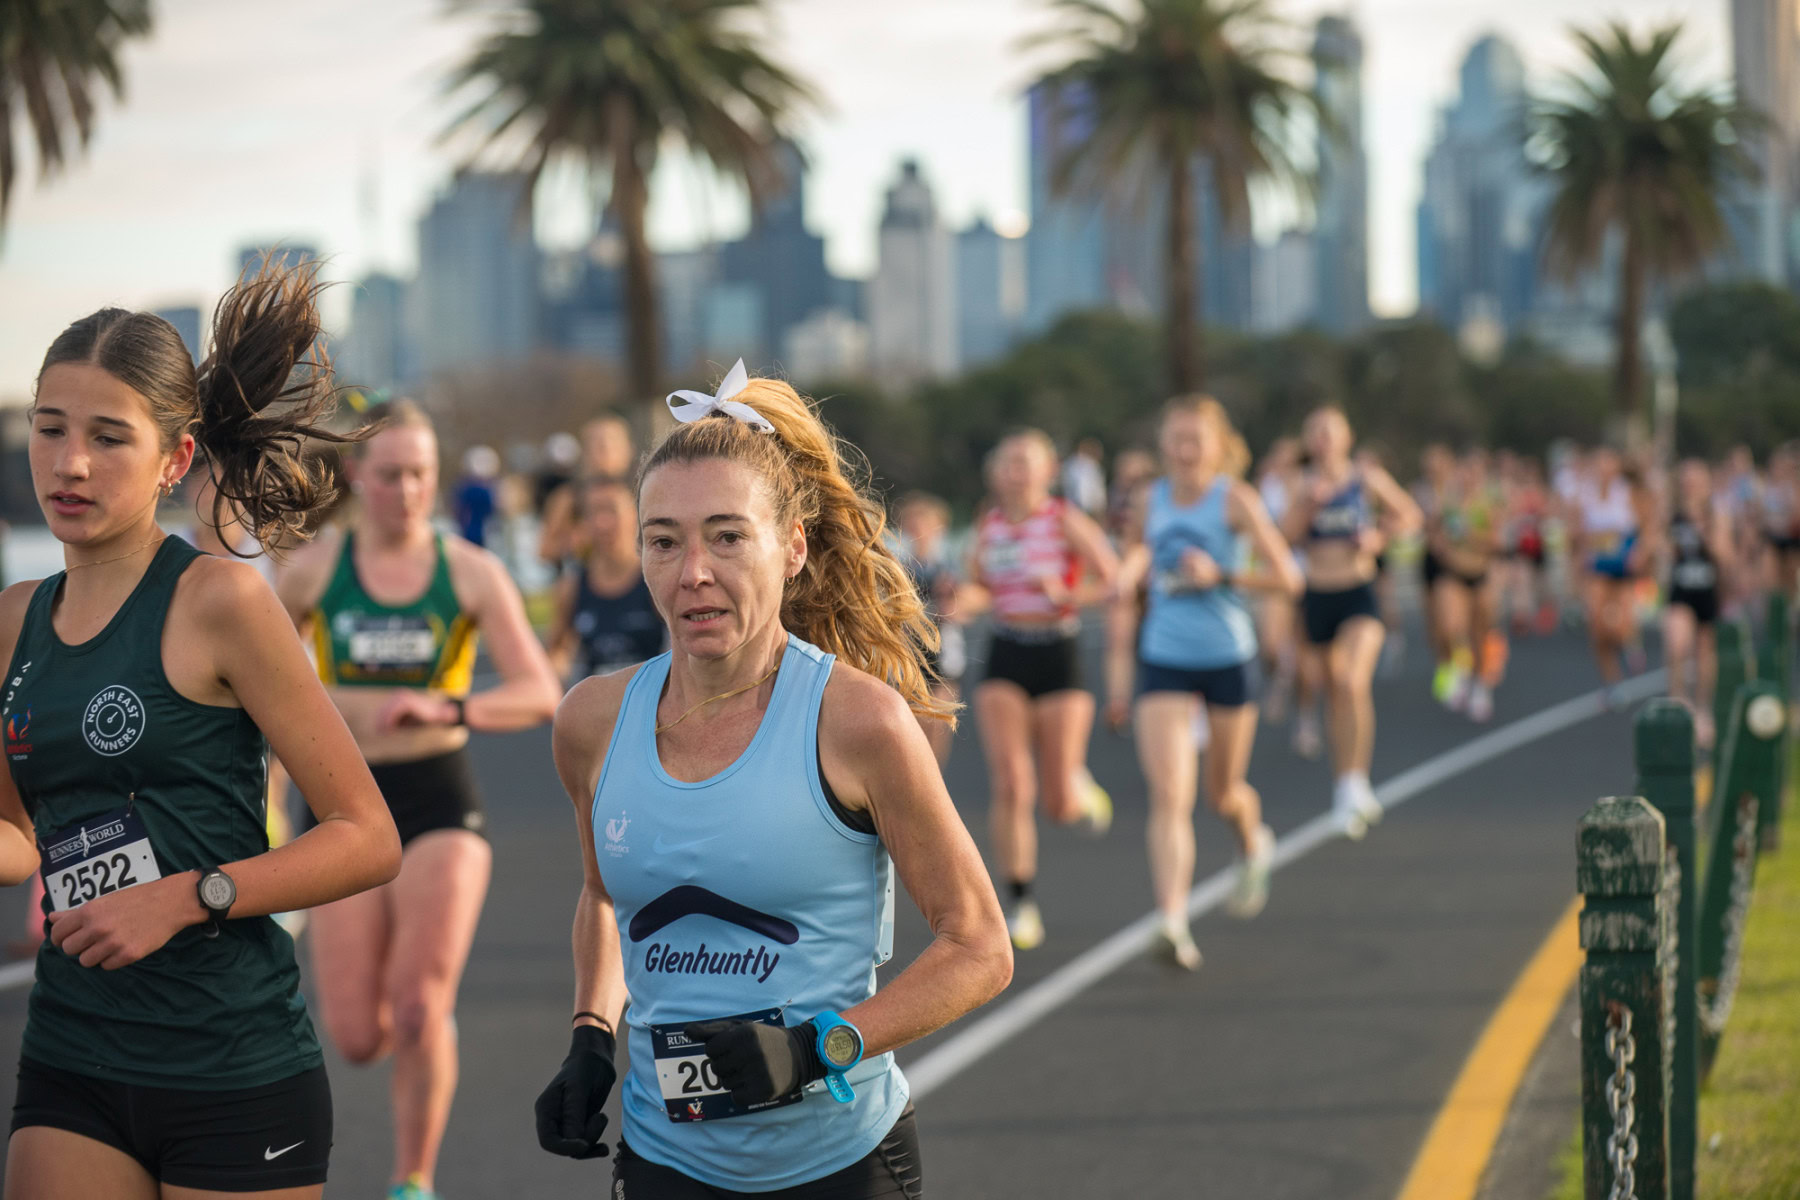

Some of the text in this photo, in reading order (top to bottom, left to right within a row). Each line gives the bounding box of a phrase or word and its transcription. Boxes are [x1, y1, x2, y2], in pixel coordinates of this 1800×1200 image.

[87, 690, 140, 723] NORTH EAST
[88, 727, 137, 751] RUNNERS
[87, 823, 125, 843] WORLD
[62, 852, 138, 909] 2522
[645, 943, 780, 984] Glenhuntly
